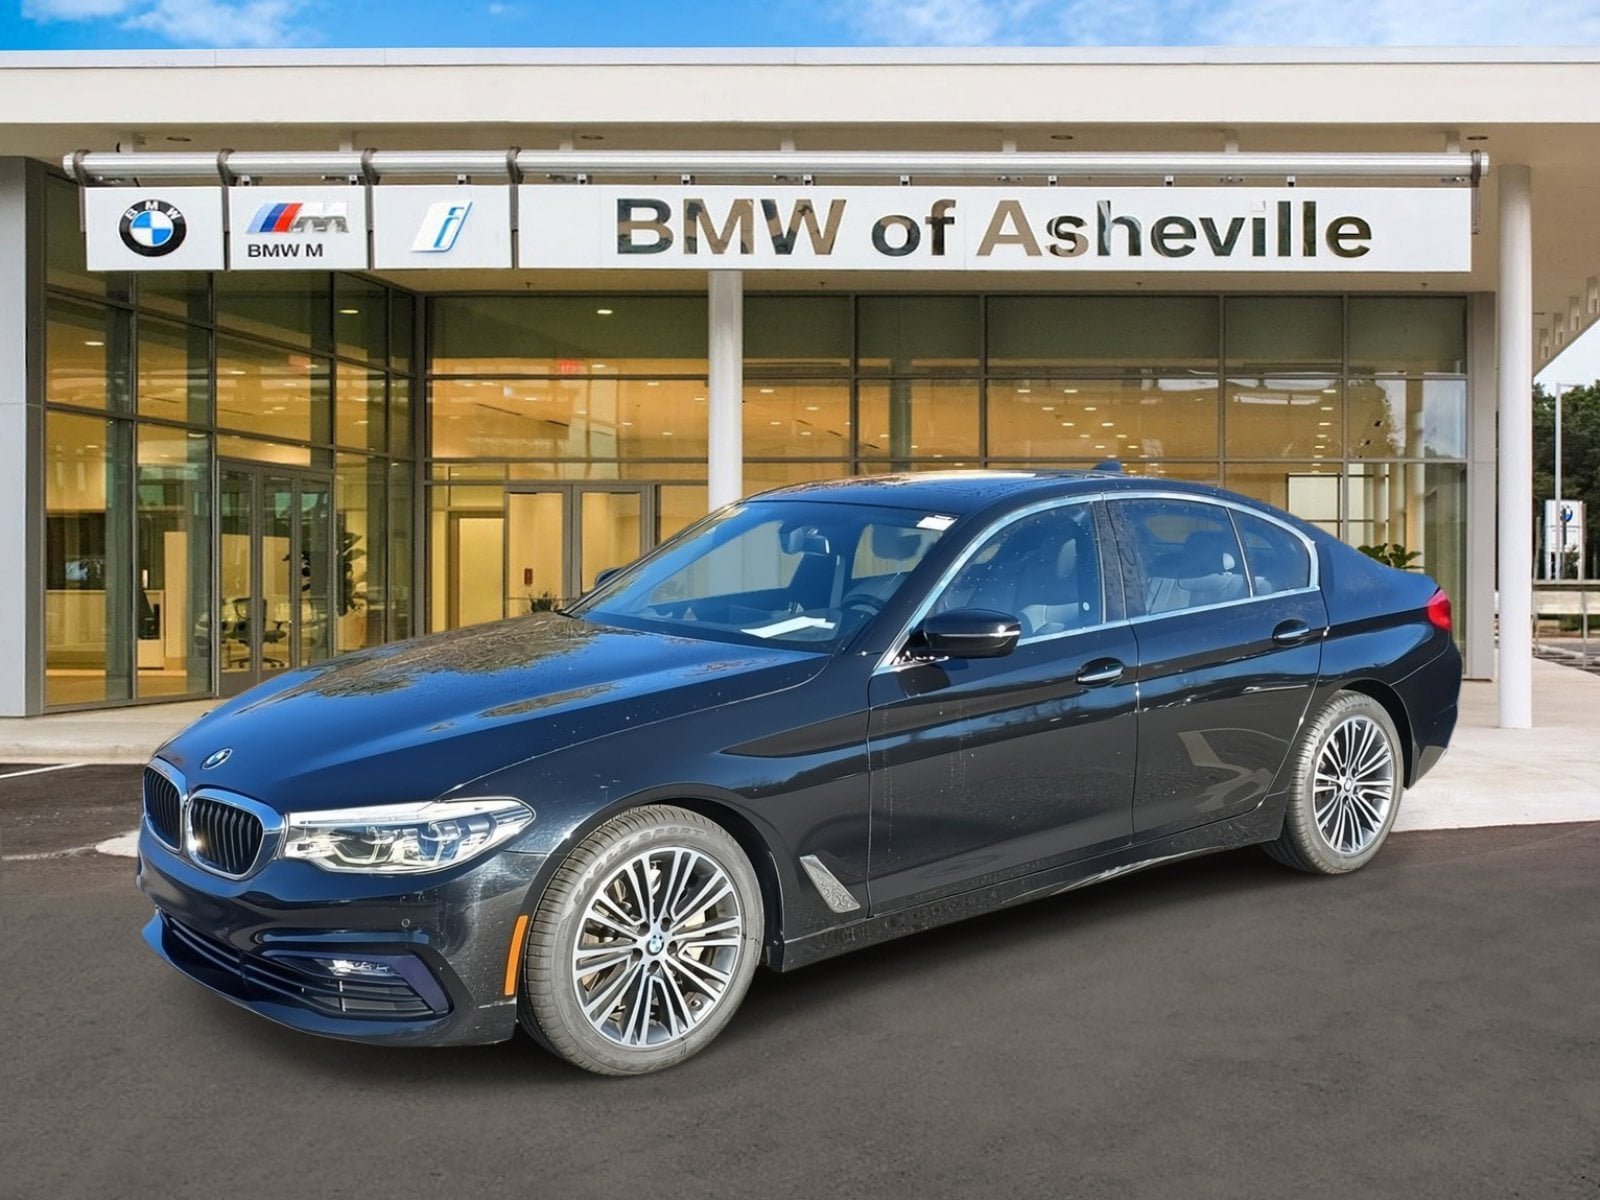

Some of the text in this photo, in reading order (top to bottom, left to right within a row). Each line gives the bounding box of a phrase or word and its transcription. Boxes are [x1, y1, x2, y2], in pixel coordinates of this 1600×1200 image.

[125, 200, 181, 220] BMW
[616, 198, 1373, 258] BMW of Asheville
[247, 243, 323, 257] BMW M
